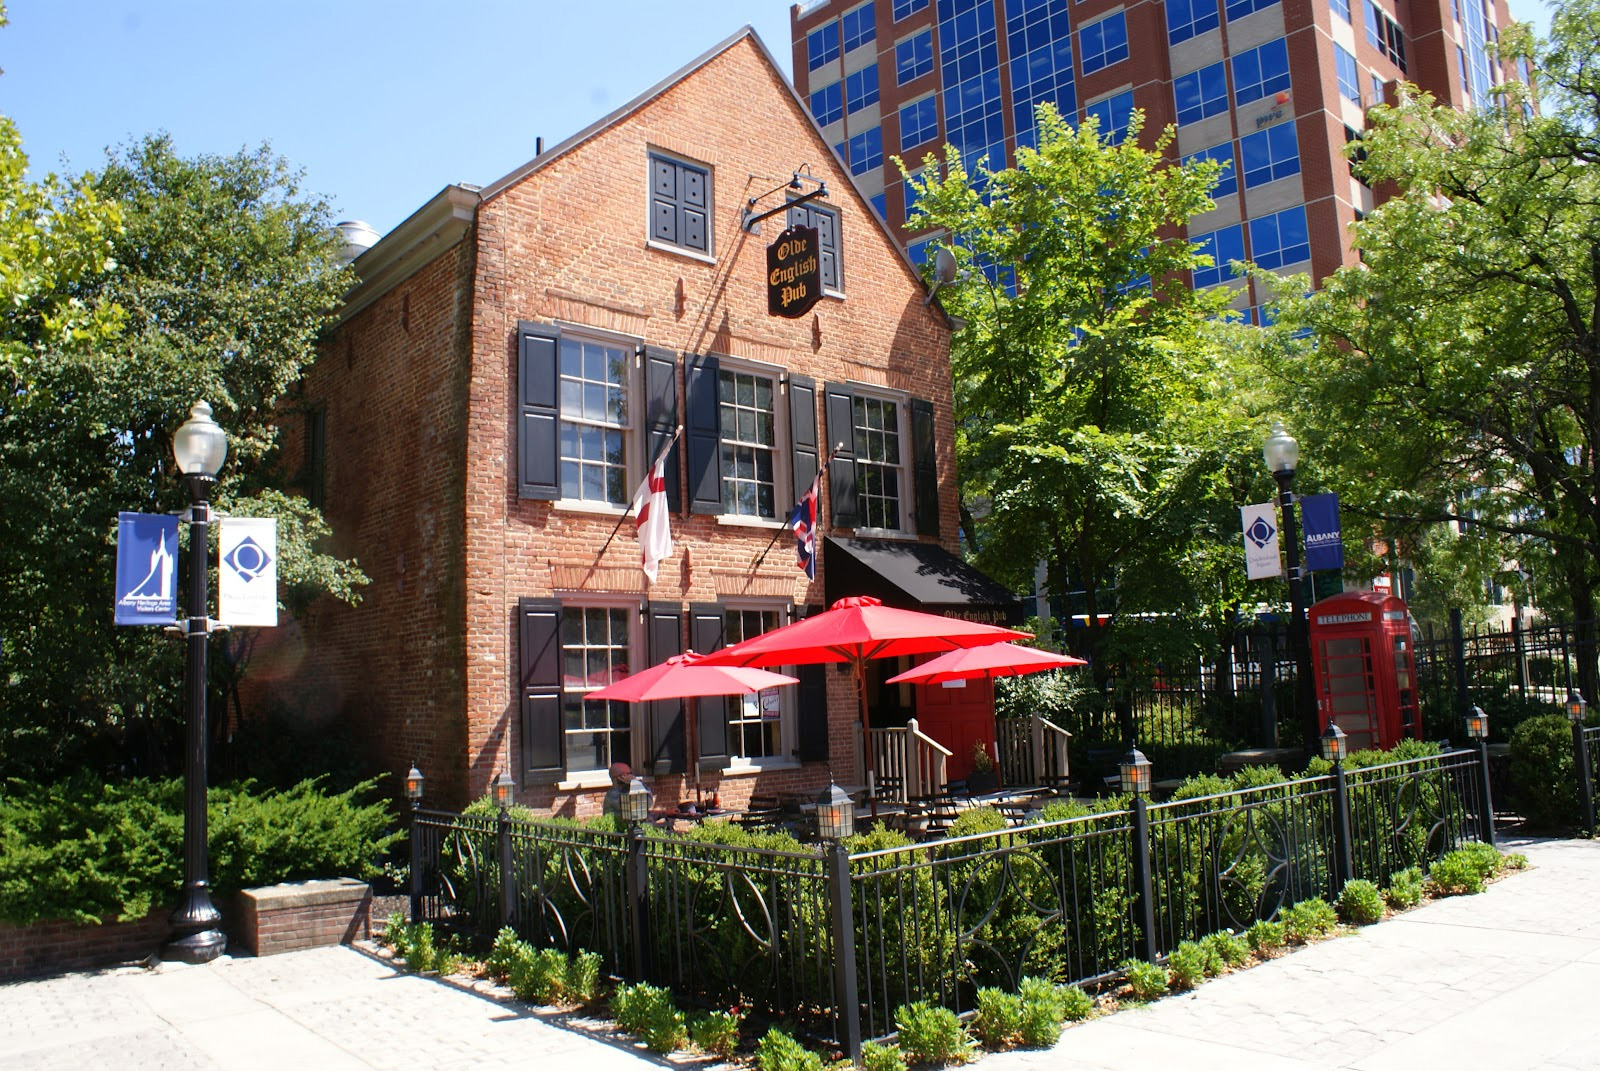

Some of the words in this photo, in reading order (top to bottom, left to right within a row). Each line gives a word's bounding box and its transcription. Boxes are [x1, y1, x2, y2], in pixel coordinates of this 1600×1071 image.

[1256, 110, 1283, 129] pwc
[777, 239, 808, 261] Olde
[769, 254, 818, 287] English
[780, 281, 808, 308] Pub
[1306, 531, 1341, 543] ALBANY
[118, 599, 137, 607] Albany
[943, 609, 962, 619] Olde
[963, 610, 991, 623] English
[993, 610, 1007, 624] Pub
[1321, 612, 1371, 624] TELEPHONE
